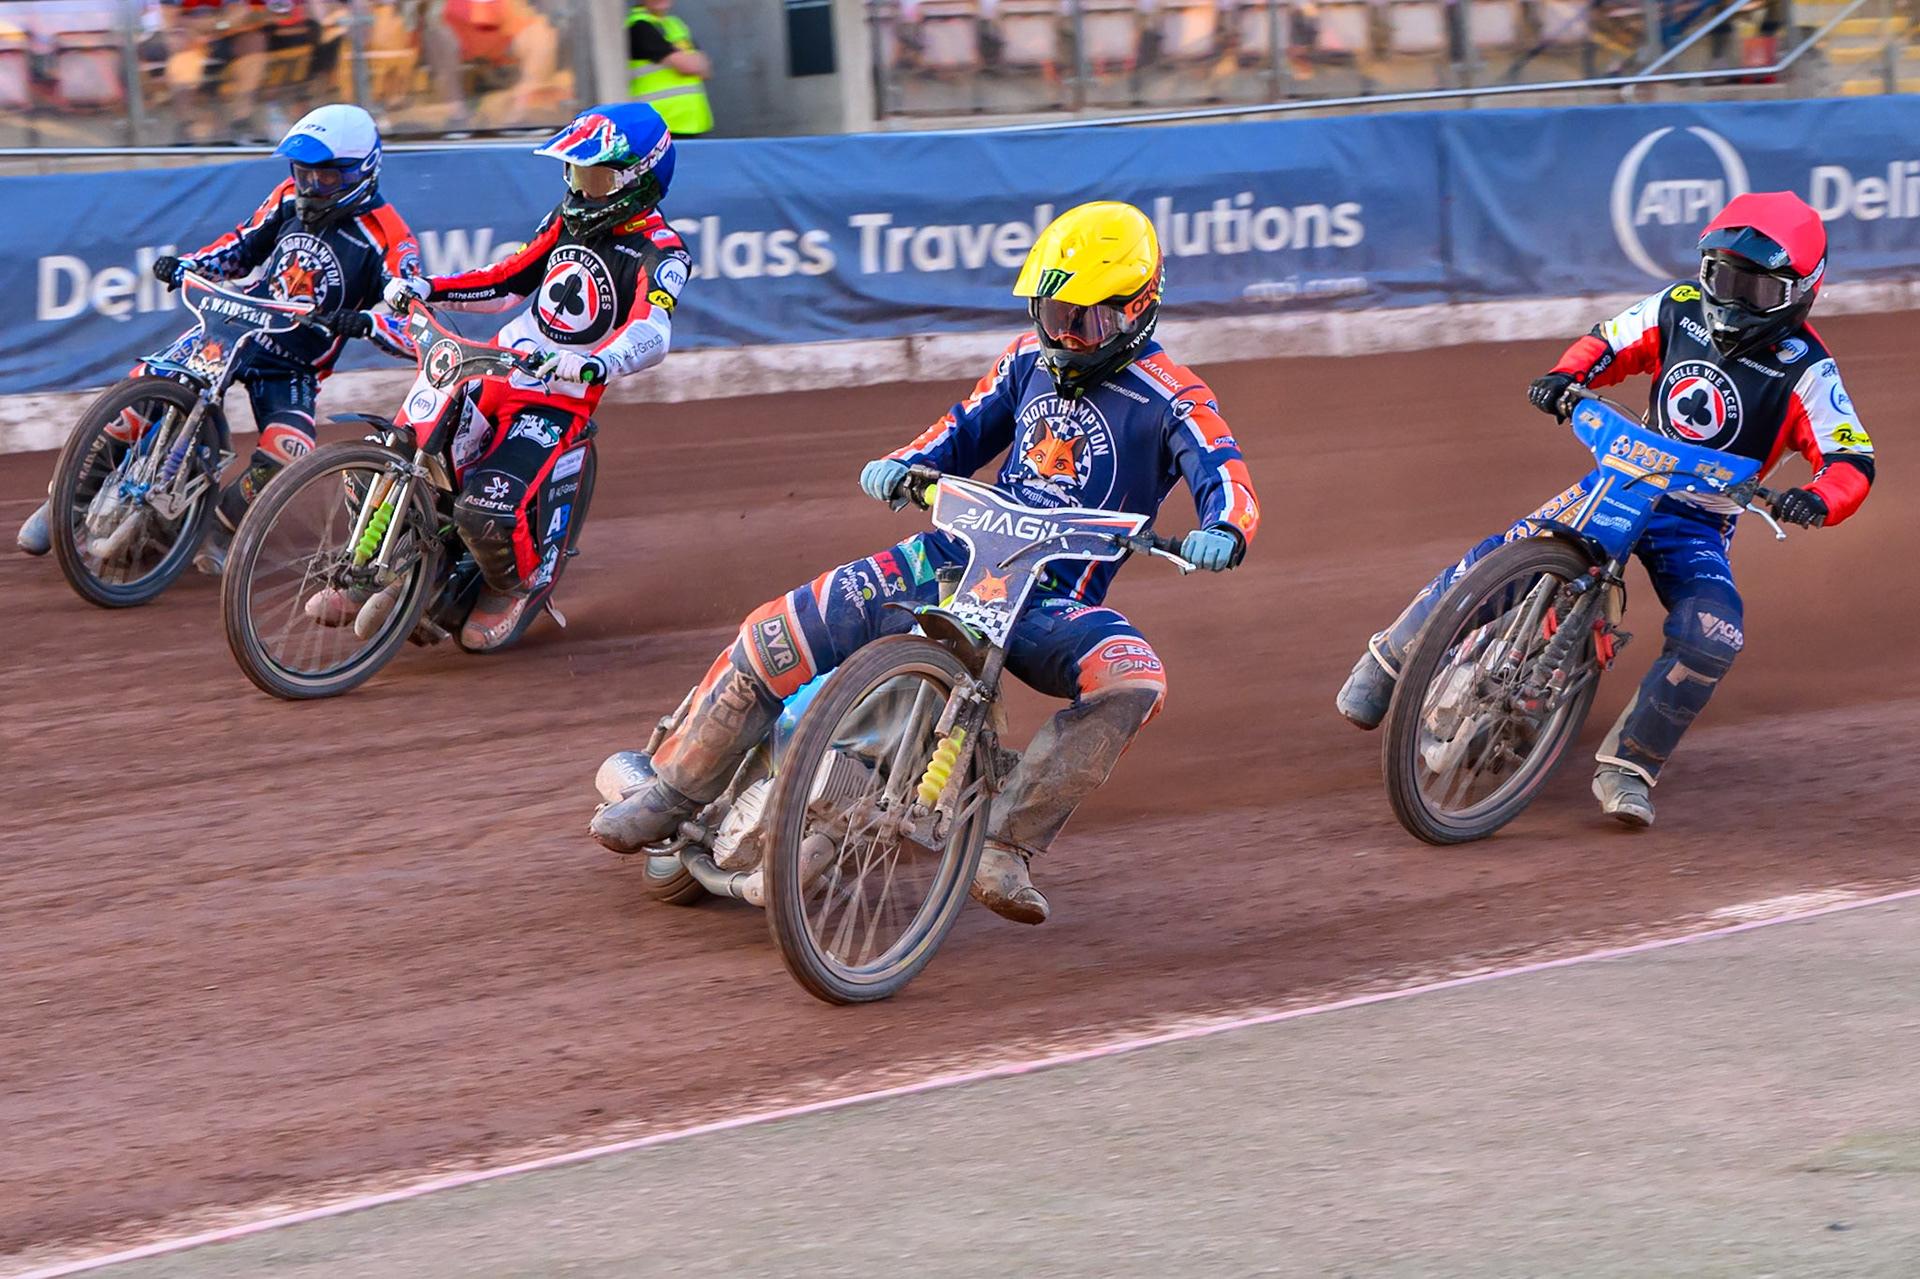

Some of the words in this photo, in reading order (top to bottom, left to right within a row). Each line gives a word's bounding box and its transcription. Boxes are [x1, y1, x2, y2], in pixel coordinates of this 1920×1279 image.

[580, 252, 600, 275] VUE
[596, 276, 612, 311] ACES
[414, 397, 432, 413] ATPI
[1668, 365, 1700, 385] BELLE
[1704, 367, 1725, 387] VUE
[1722, 389, 1738, 419] ACES
[1021, 398, 1109, 456] NORTHAMPTON
[1628, 440, 1680, 477] PSH
[972, 507, 1077, 550] MAGIK
[762, 619, 794, 669] DVR
[1103, 644, 1160, 662] CBS
[1110, 659, 1161, 676] BINS
